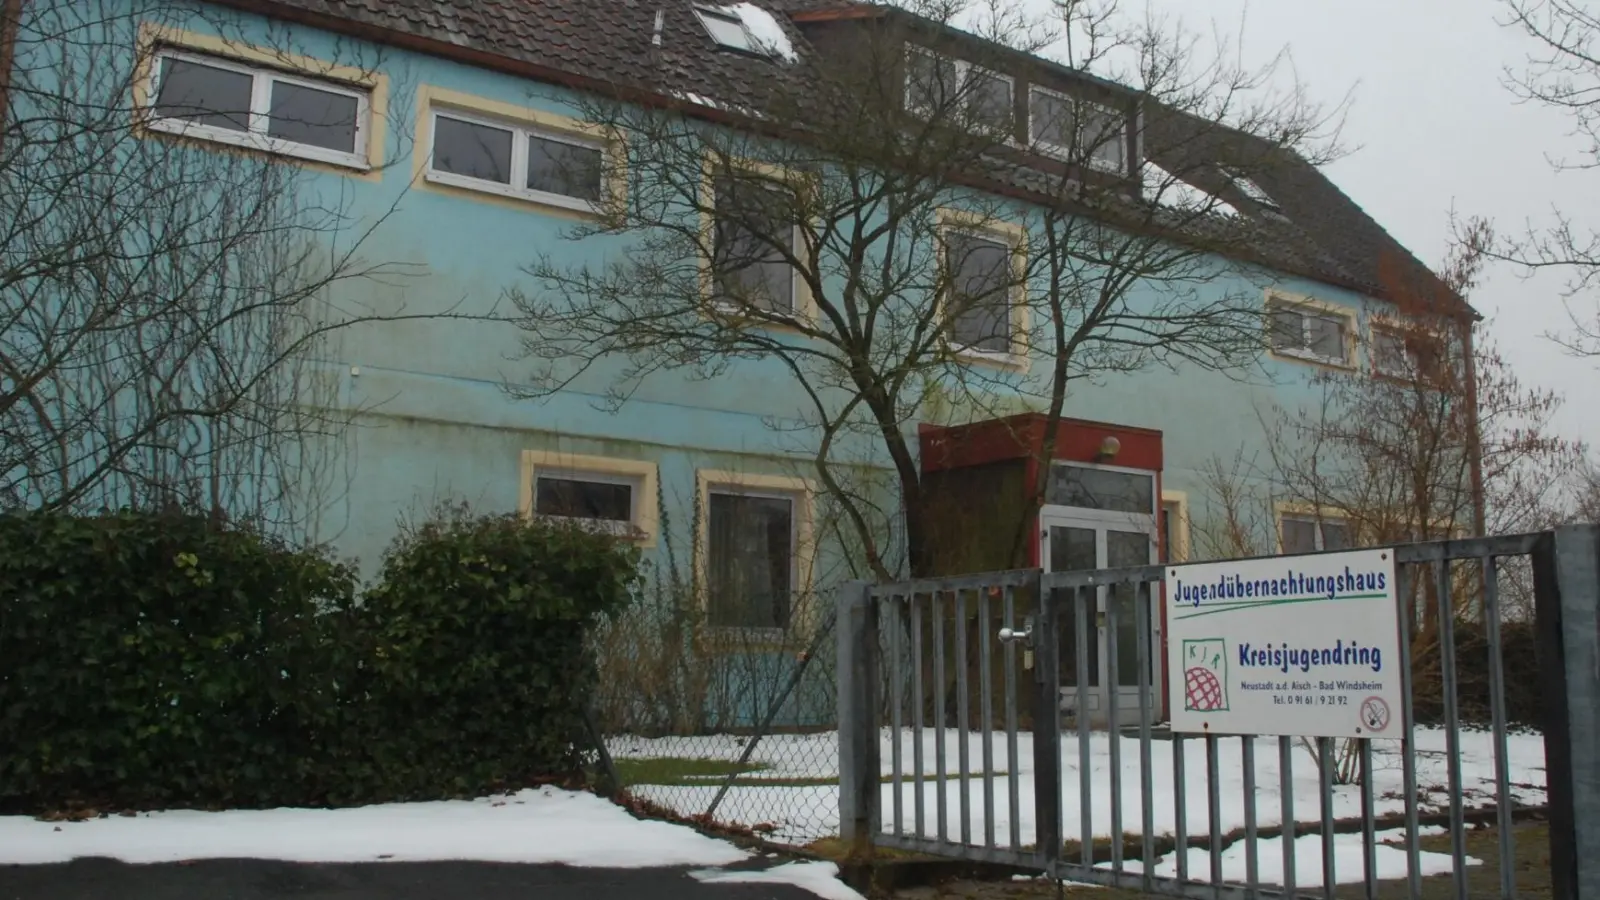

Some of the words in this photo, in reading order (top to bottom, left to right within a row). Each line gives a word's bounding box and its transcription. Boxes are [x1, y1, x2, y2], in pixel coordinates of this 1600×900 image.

[1174, 566, 1386, 607] Jugendübernachtungshaus
[1238, 640, 1382, 673] Kreisjugendring
[1241, 681, 1273, 690] Neustadt
[1291, 681, 1311, 690] Aisch
[1319, 681, 1334, 690] Bad
[1335, 681, 1382, 690] Windsheim
[1273, 695, 1286, 705] Tel.
